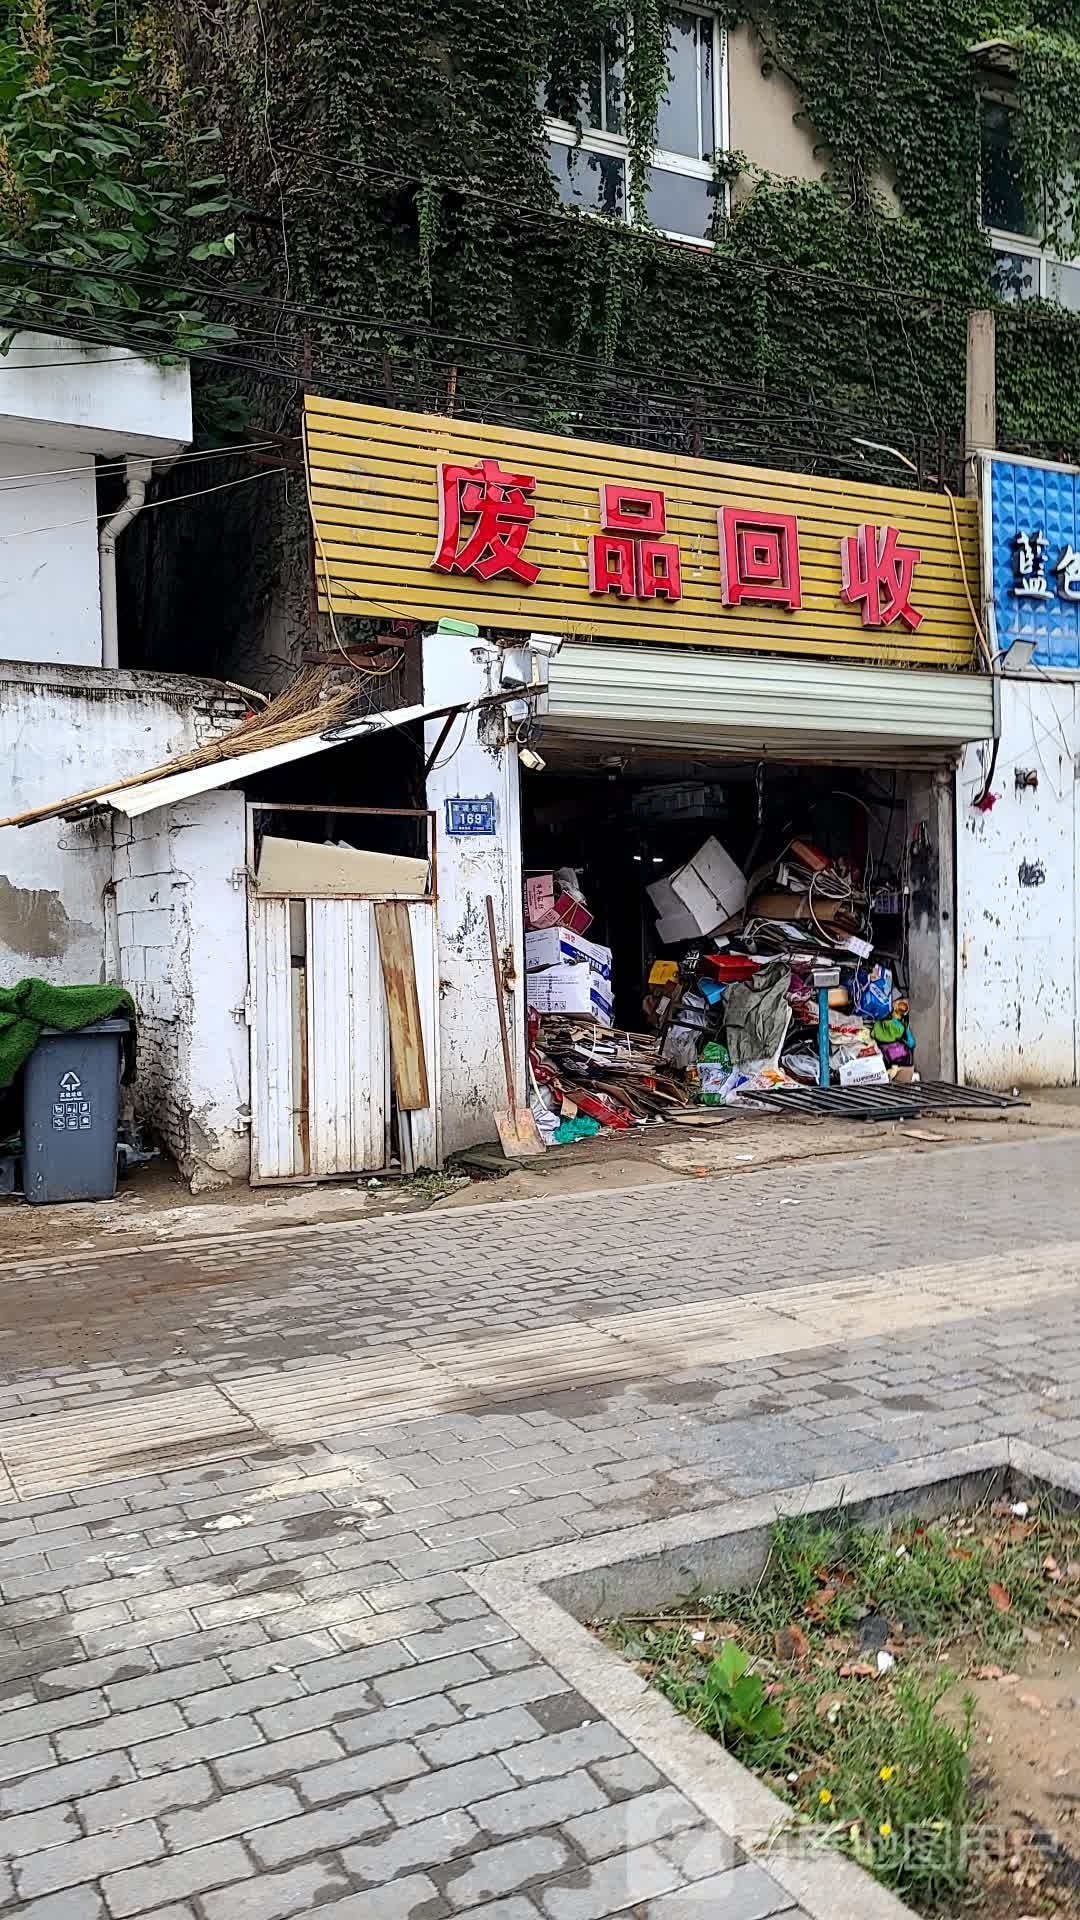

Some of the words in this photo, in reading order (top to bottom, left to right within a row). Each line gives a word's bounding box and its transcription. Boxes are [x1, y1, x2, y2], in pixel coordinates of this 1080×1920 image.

[430, 459, 925, 632] 废品回收
[460, 813, 482, 825] 169
